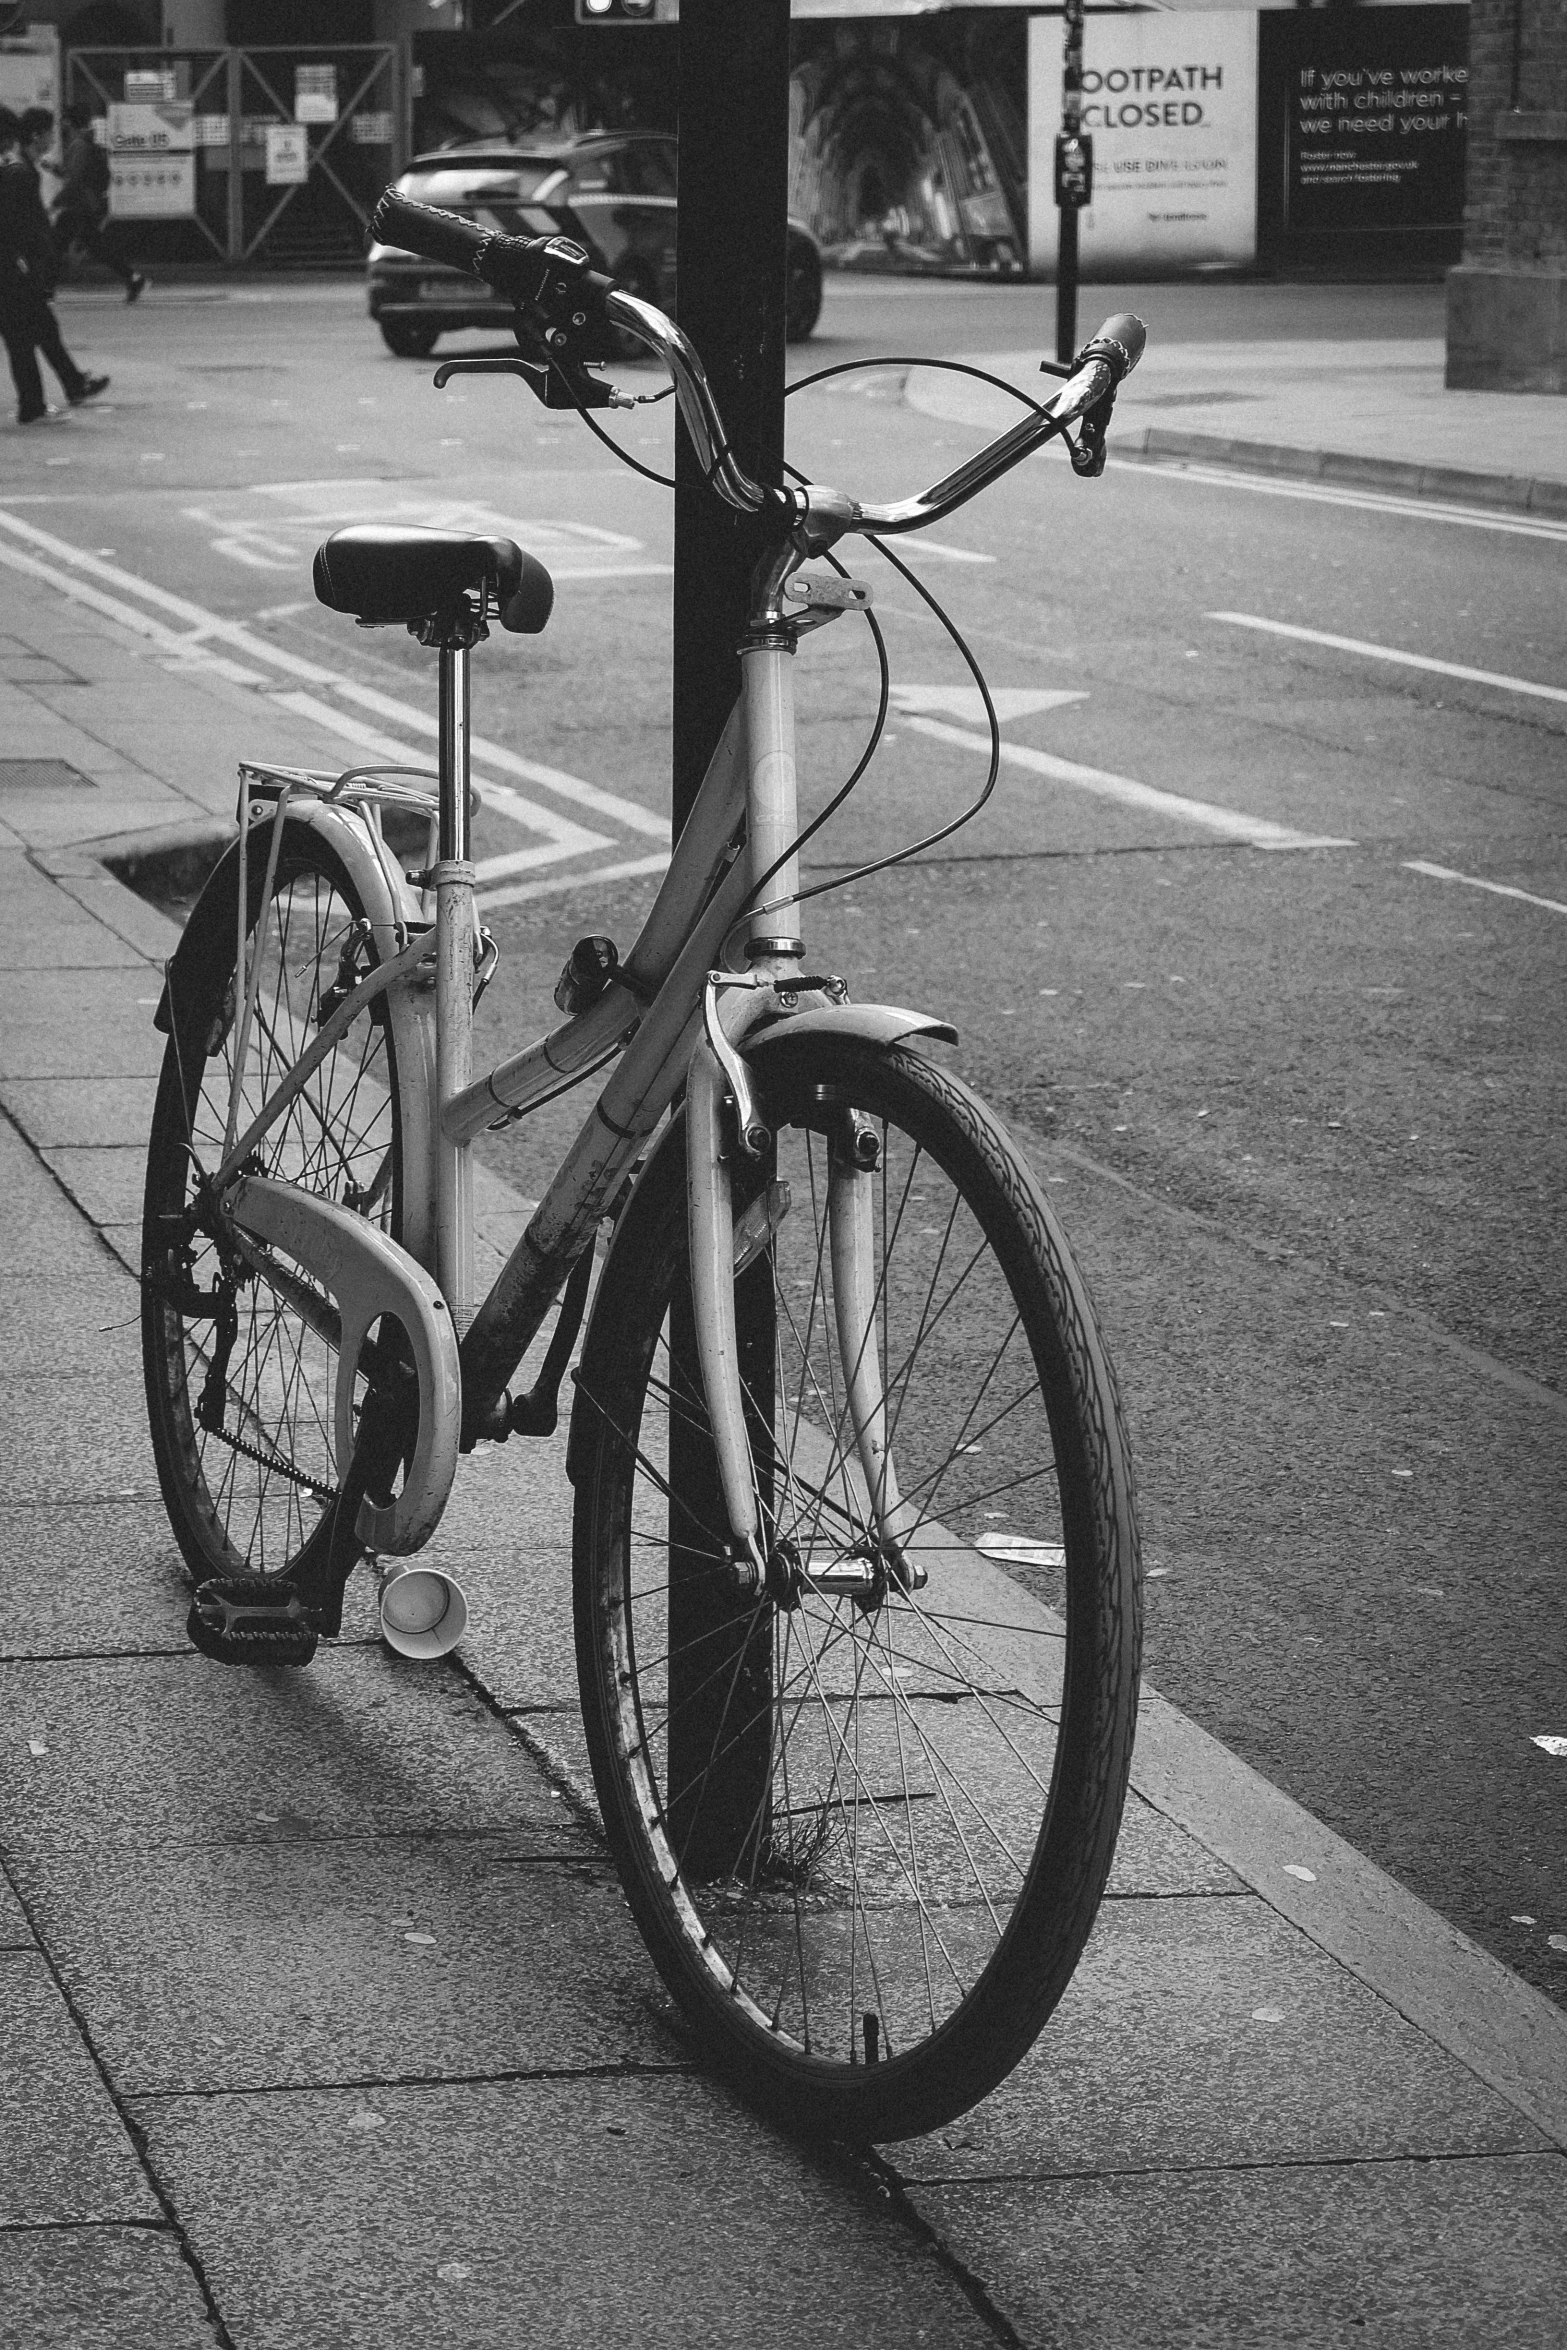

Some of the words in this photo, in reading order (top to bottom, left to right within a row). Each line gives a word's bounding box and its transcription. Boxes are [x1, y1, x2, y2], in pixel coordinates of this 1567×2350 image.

[1081, 65, 1223, 93] OOTPATH
[1300, 68, 1316, 87] If
[1321, 68, 1395, 90] you've
[1400, 65, 1469, 85] worke
[1299, 92, 1349, 110] with
[1353, 89, 1445, 109] children
[1081, 102, 1204, 128] CLOSED
[1299, 116, 1332, 133] we
[1338, 113, 1395, 133] need
[1400, 113, 1451, 135] your
